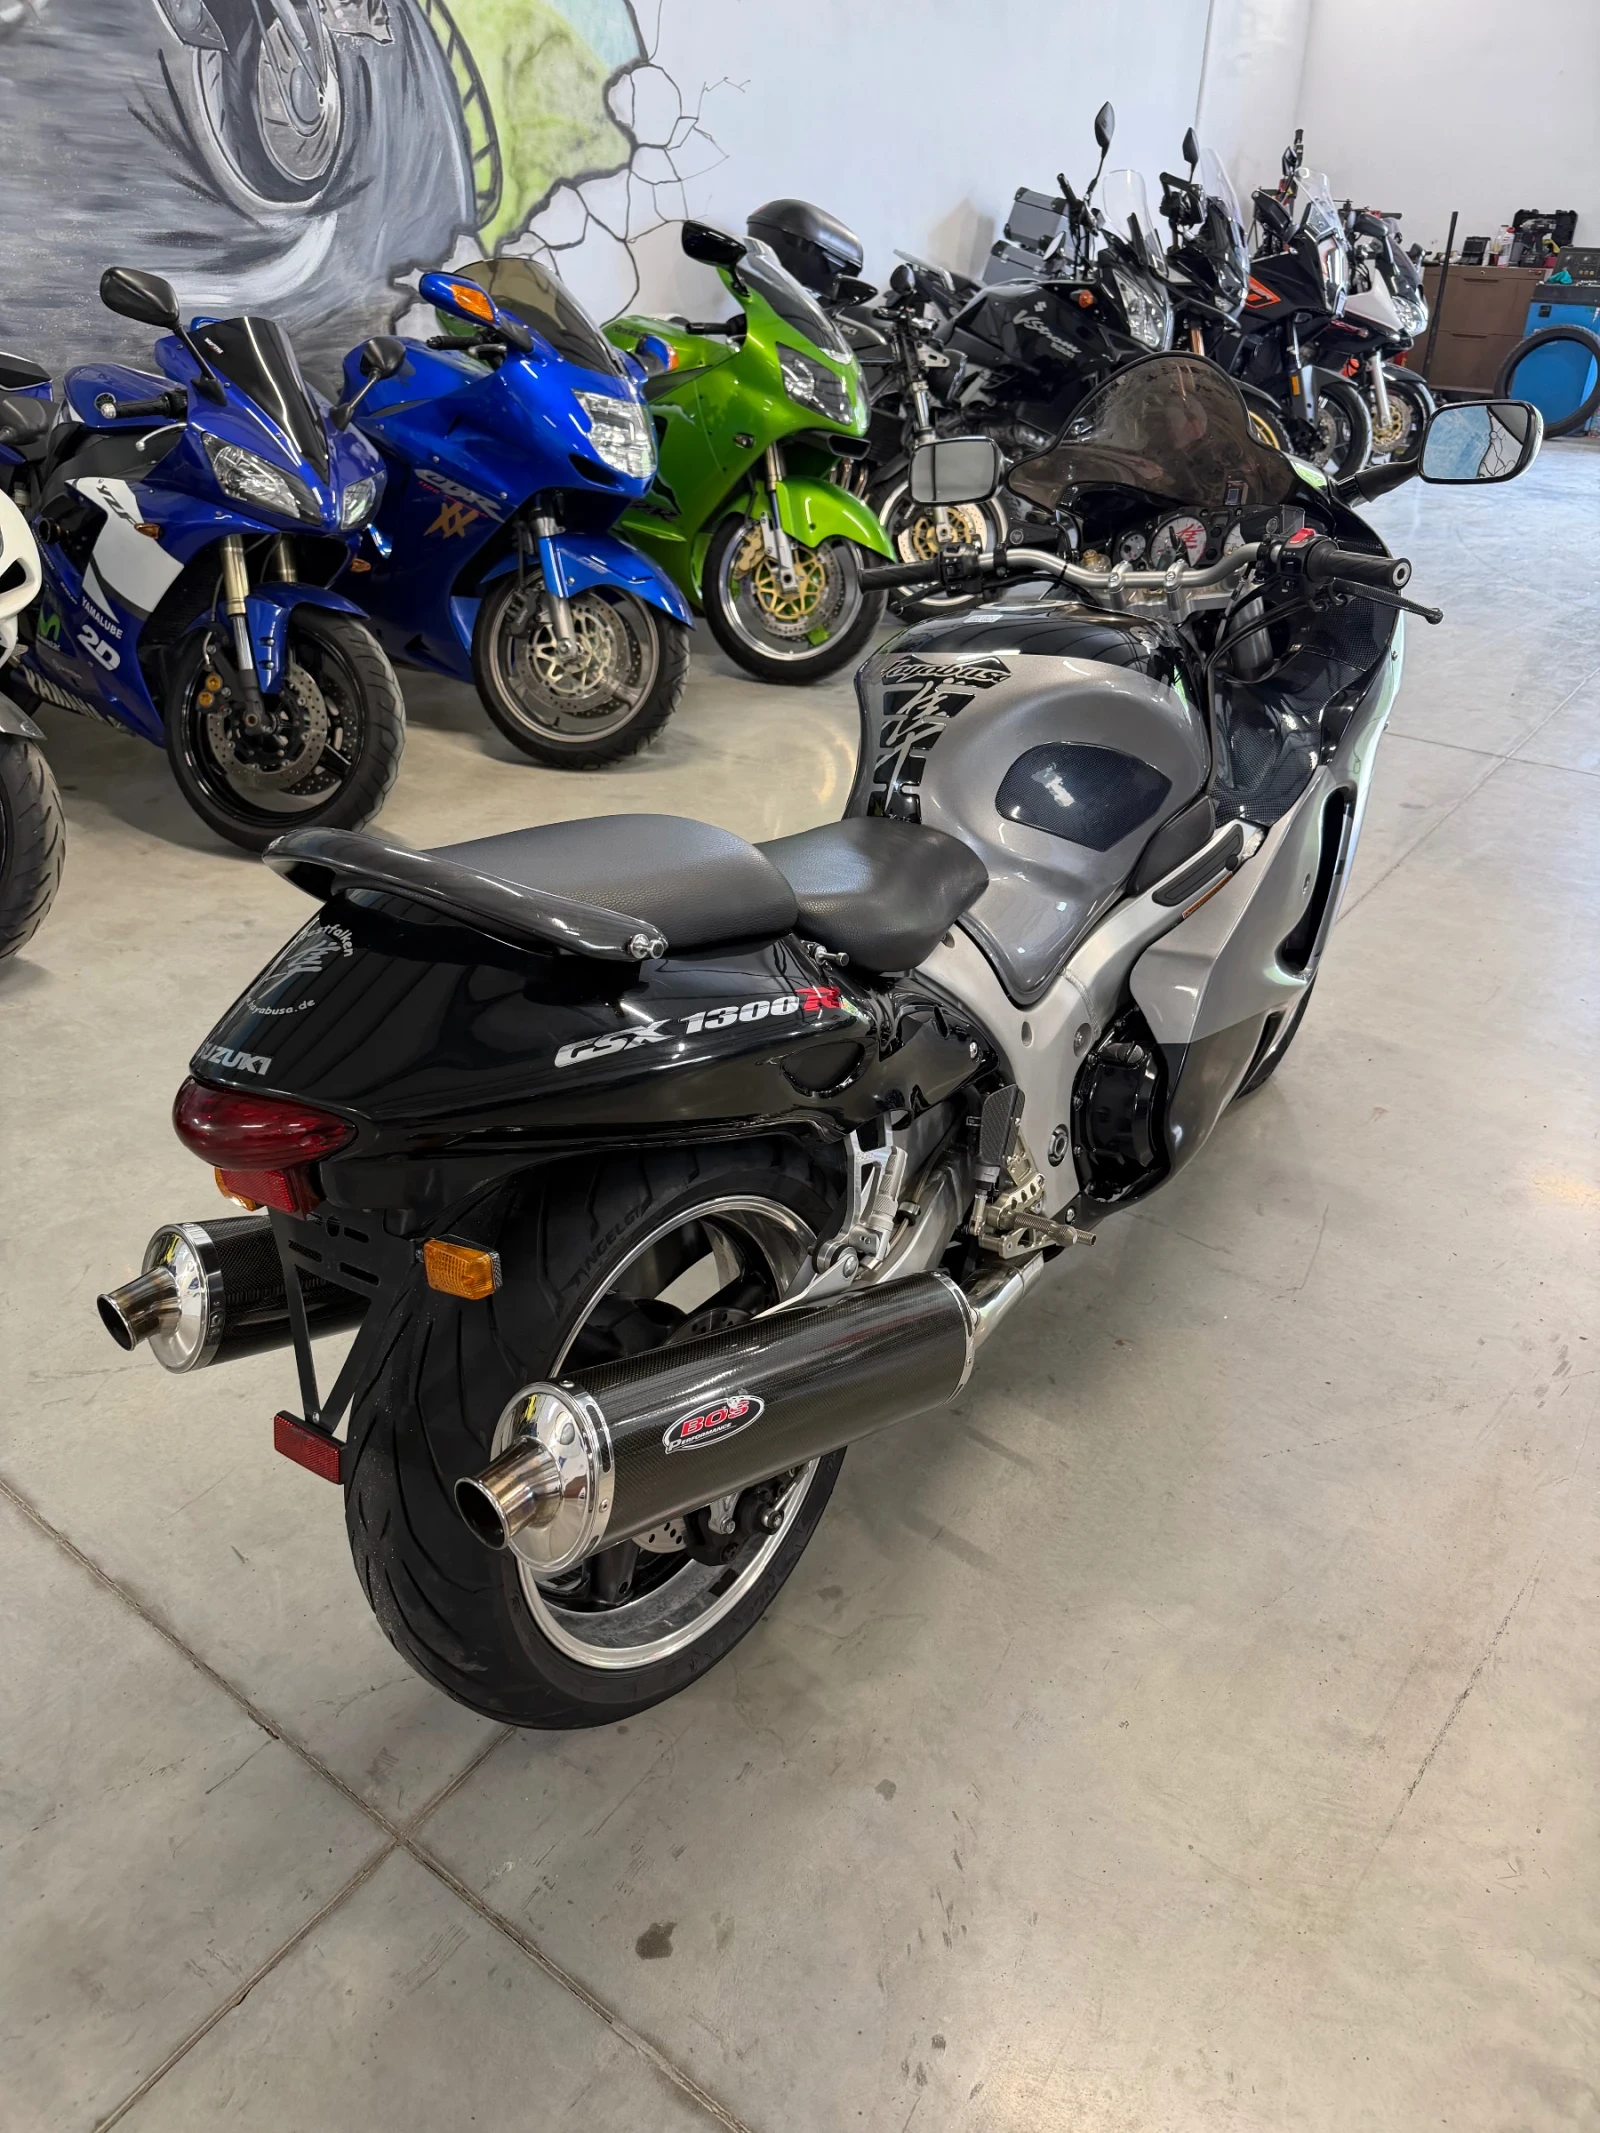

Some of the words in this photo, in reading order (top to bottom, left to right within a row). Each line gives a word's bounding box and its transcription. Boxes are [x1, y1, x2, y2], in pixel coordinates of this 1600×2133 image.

[414, 468, 506, 523] CBR
[423, 502, 479, 538] XX
[81, 595, 124, 640] YAMALUBE
[554, 1018, 676, 1068] GSX
[678, 986, 841, 1035] 1300R
[680, 1400, 750, 1438] BOS
